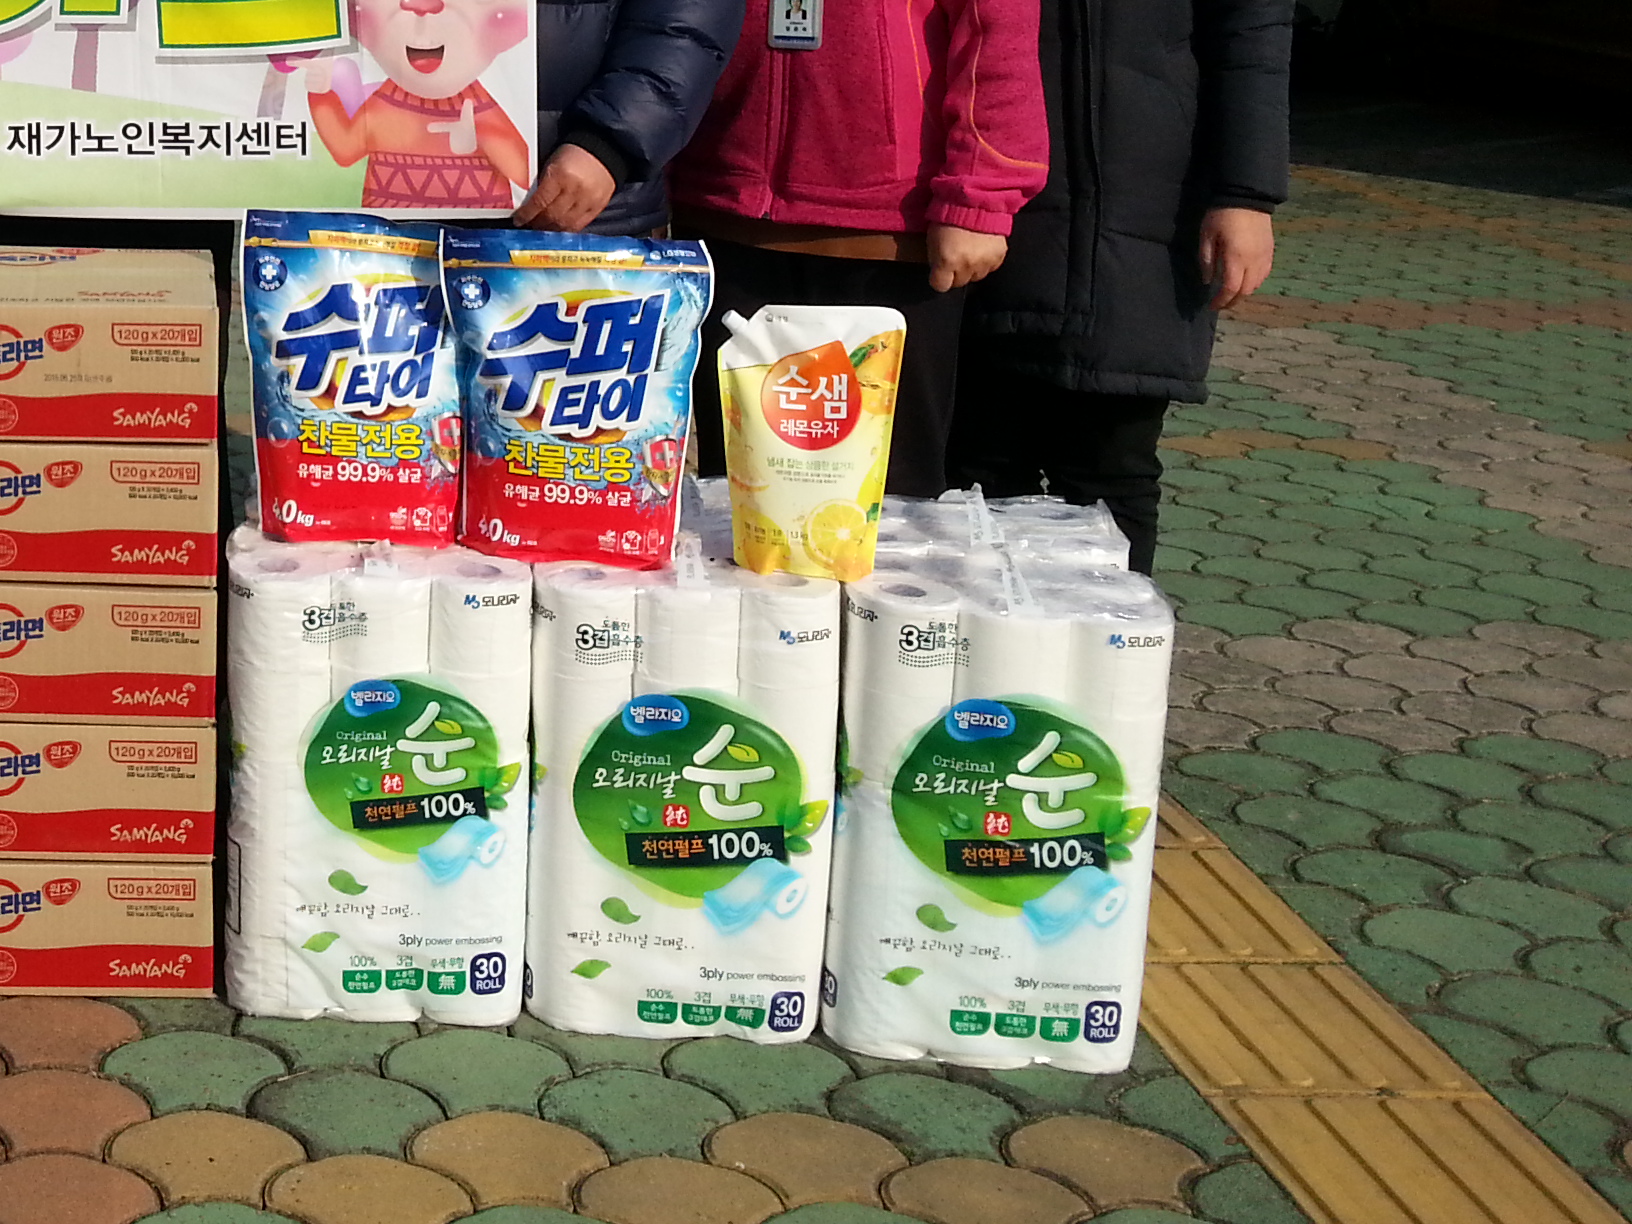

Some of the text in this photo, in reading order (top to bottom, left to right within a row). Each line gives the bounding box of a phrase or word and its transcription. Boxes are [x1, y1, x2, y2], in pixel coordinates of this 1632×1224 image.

[6, 120, 309, 158] 재가노인복지센터
[275, 283, 445, 392] 수퍼
[479, 296, 666, 412] 수퍼
[342, 355, 434, 405] 타이
[549, 374, 649, 431] 타이
[771, 365, 848, 420] 순샘
[112, 407, 191, 428] SAMYANG
[779, 419, 840, 438] 레몬유자
[298, 420, 424, 460] 찬물전용
[504, 439, 635, 483] 찬물전용
[297, 461, 421, 484] 유해균 99.9% 살균
[503, 483, 632, 507] 유해균 99.9% 살균
[111, 544, 190, 565] SAMYANG
[112, 687, 190, 707] SAMYANG
[351, 690, 395, 707] 벨라지오
[630, 705, 682, 724] 벨라지오
[954, 710, 1008, 729] 벨라지오
[336, 730, 388, 742] Original
[396, 701, 476, 786] 순
[320, 743, 396, 770] 오리지날
[611, 750, 672, 767] Original
[932, 754, 996, 774] Original
[681, 723, 776, 821] 순
[1005, 730, 1098, 829] 순
[592, 767, 682, 800] 오리지날
[912, 772, 1005, 806] 오리지날
[365, 792, 477, 822] 천연펄프 100%
[110, 823, 188, 844] SAMYANG
[642, 831, 773, 859] 천연펄프 100%
[961, 839, 1095, 868] 천연펄프 100%
[398, 933, 423, 947] 3ply
[425, 936, 453, 946] power
[109, 959, 186, 978] SAMYANG
[474, 956, 503, 978] 30
[699, 966, 725, 982] 3ply
[726, 972, 755, 982] power
[476, 979, 502, 991] ROLL
[1014, 976, 1040, 991] 3ply
[1041, 981, 1071, 991] power
[774, 996, 802, 1018] 30
[1089, 1005, 1119, 1027] 30
[773, 1017, 800, 1028] ROLL
[1089, 1026, 1117, 1039] ROLL
